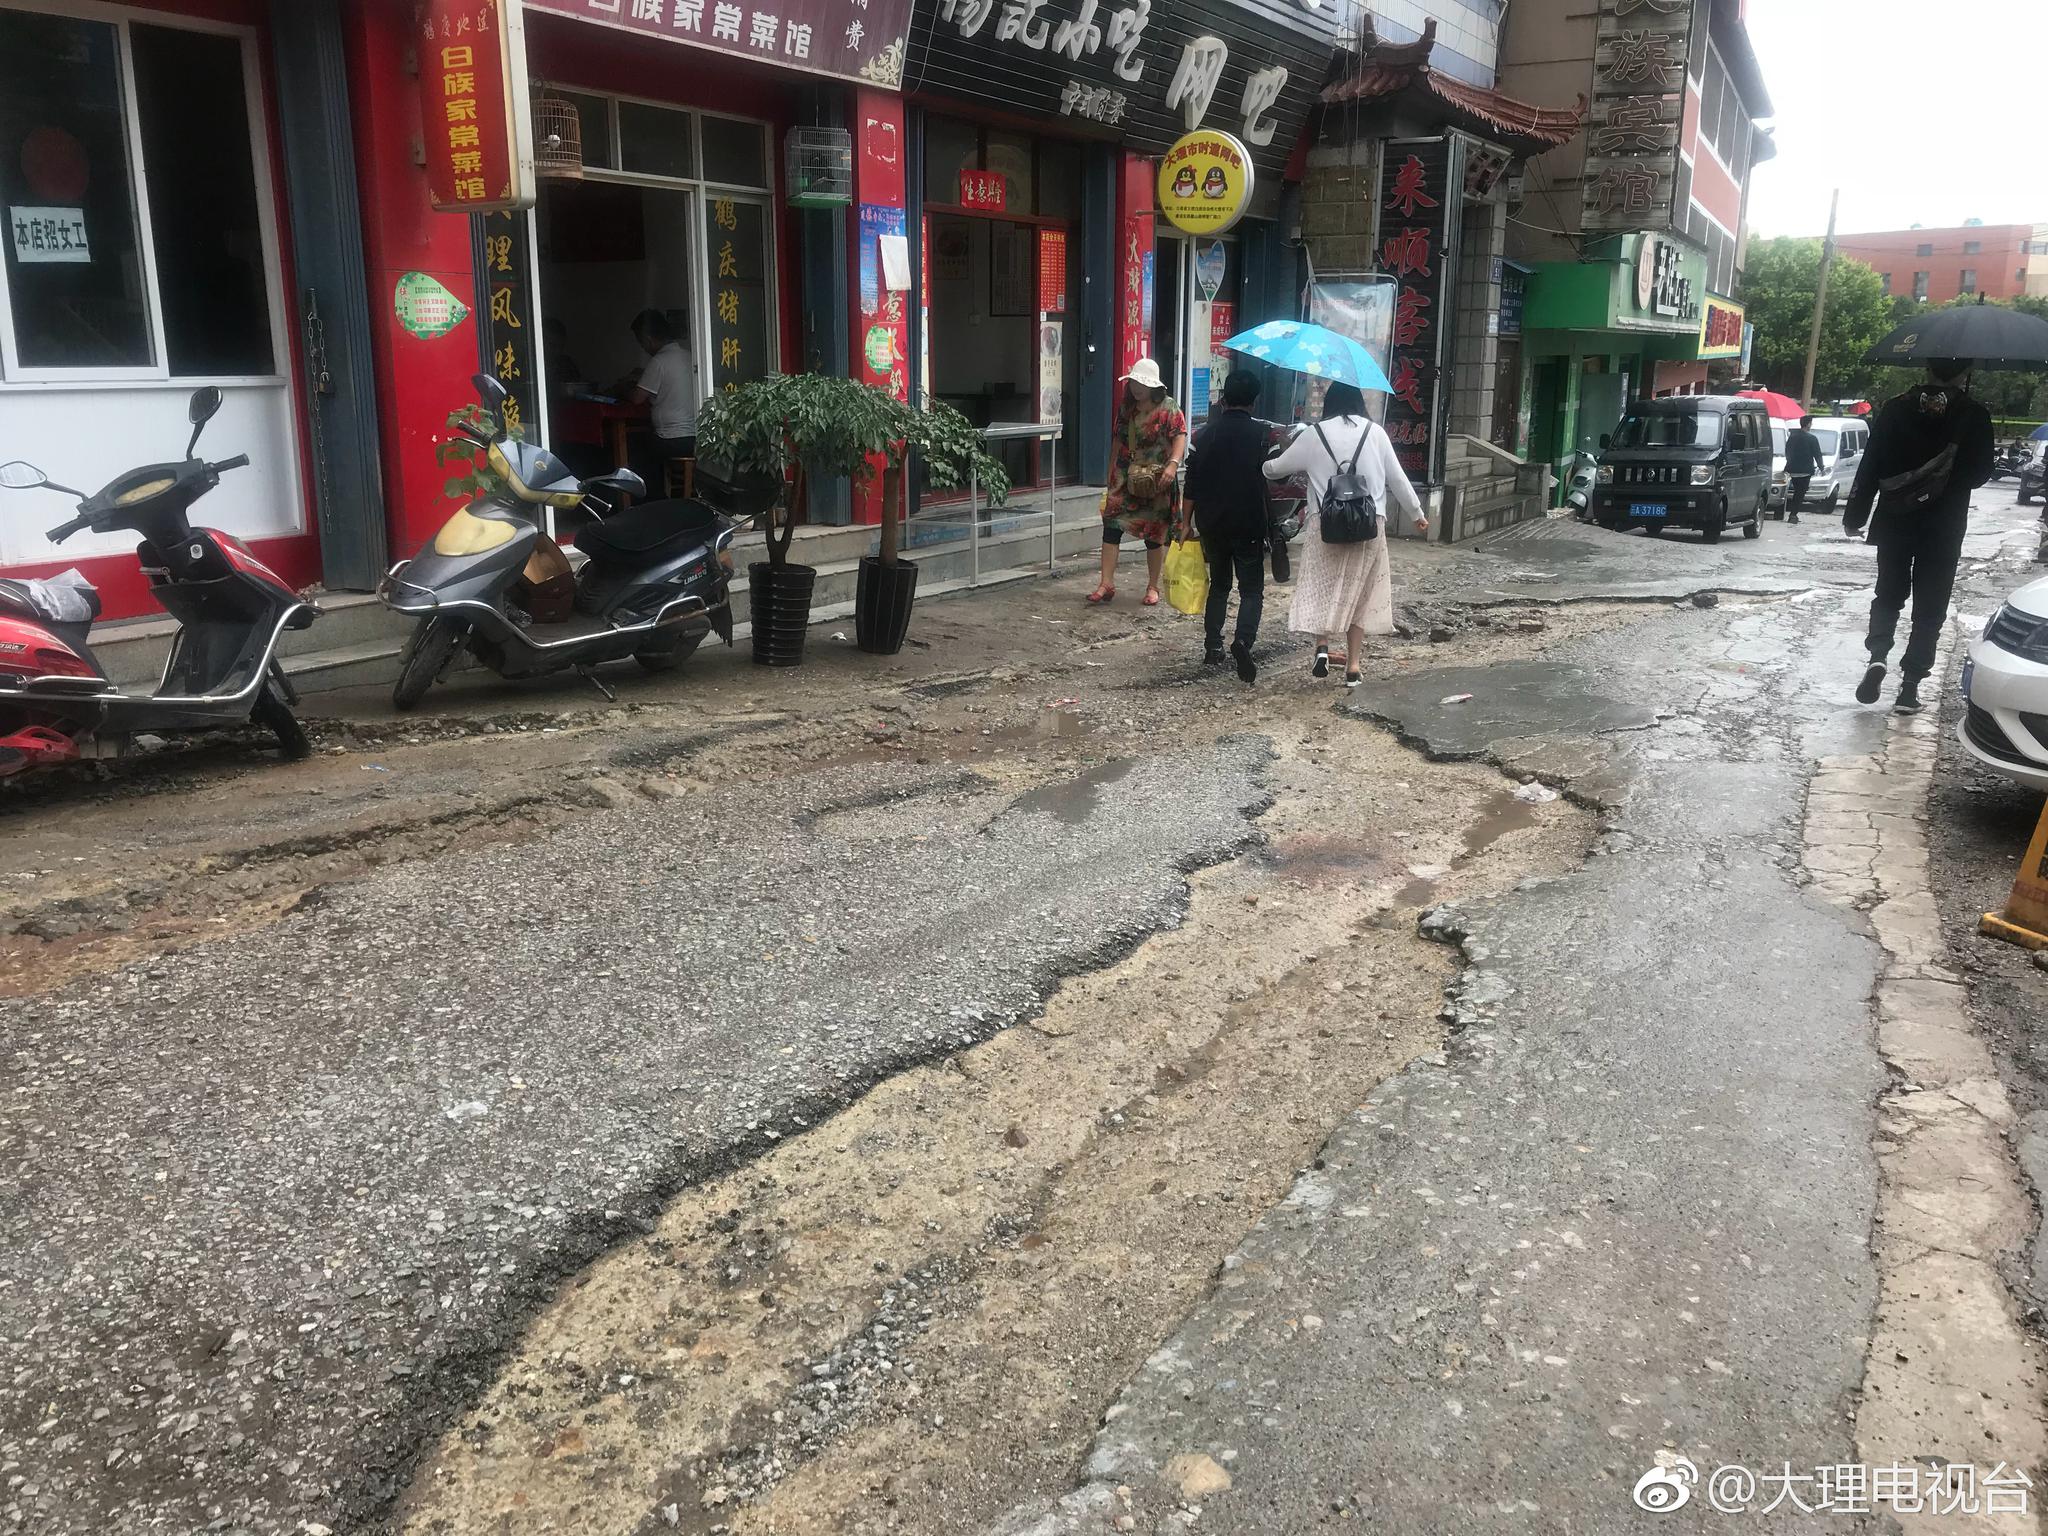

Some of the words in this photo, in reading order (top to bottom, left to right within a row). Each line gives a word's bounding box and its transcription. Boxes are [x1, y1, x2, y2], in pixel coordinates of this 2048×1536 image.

[440, 45, 486, 200] 白族家常菜馆
[1165, 35, 1288, 146] 网吧
[1590, 0, 1683, 215] 族宾馆
[15, 217, 88, 250] 本店招女工
